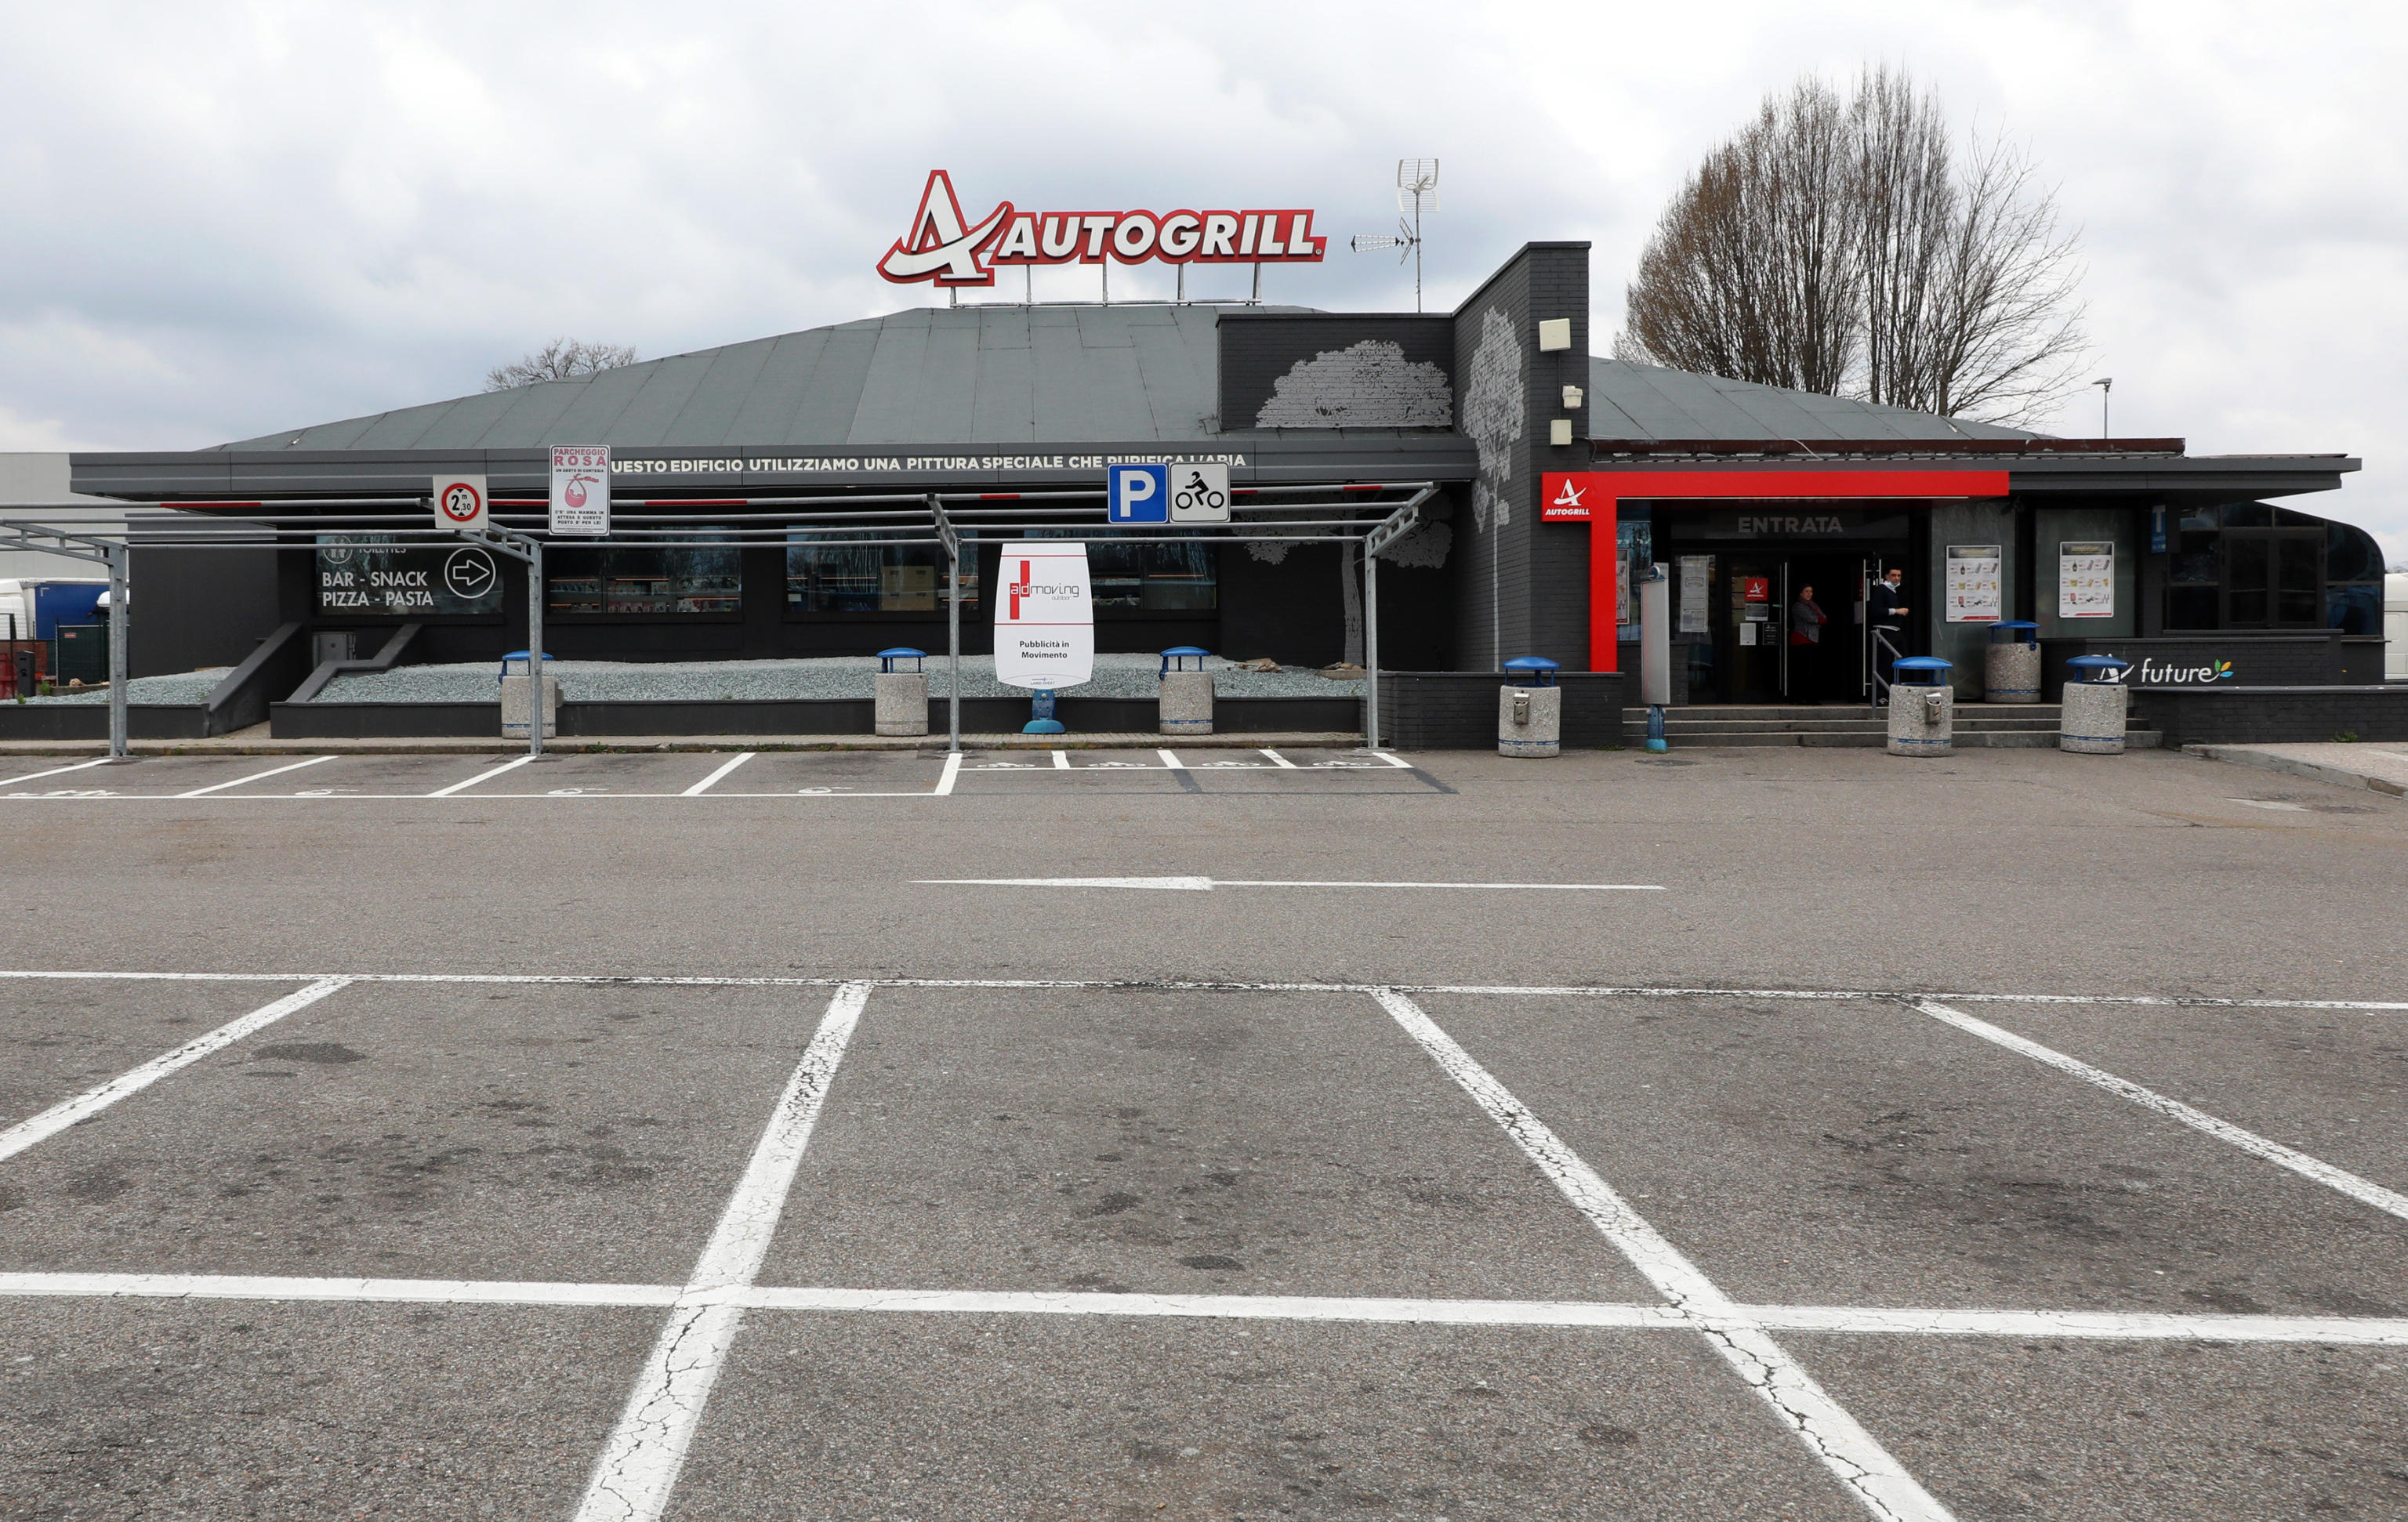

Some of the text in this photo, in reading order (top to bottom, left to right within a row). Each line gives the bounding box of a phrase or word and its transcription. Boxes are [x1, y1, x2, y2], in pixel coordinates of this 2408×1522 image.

[553, 455, 607, 466] ROSA
[611, 459, 667, 473] UESTO
[670, 458, 744, 473] EDIFICIO
[749, 458, 859, 471] UTILIZZIAMO
[864, 458, 901, 470] UNA
[907, 457, 980, 469] PITTURA
[982, 456, 1064, 469] SPECIALE
[1068, 455, 1102, 469] CHE
[1119, 470, 1156, 517] P
[1738, 516, 1843, 533] ENTRATA
[322, 572, 354, 587] BAR
[370, 571, 428, 586] SNACK
[1010, 583, 1079, 597] admoving
[322, 592, 369, 607] PIZZA
[386, 591, 434, 606] PASTA
[2141, 658, 2220, 683] future
